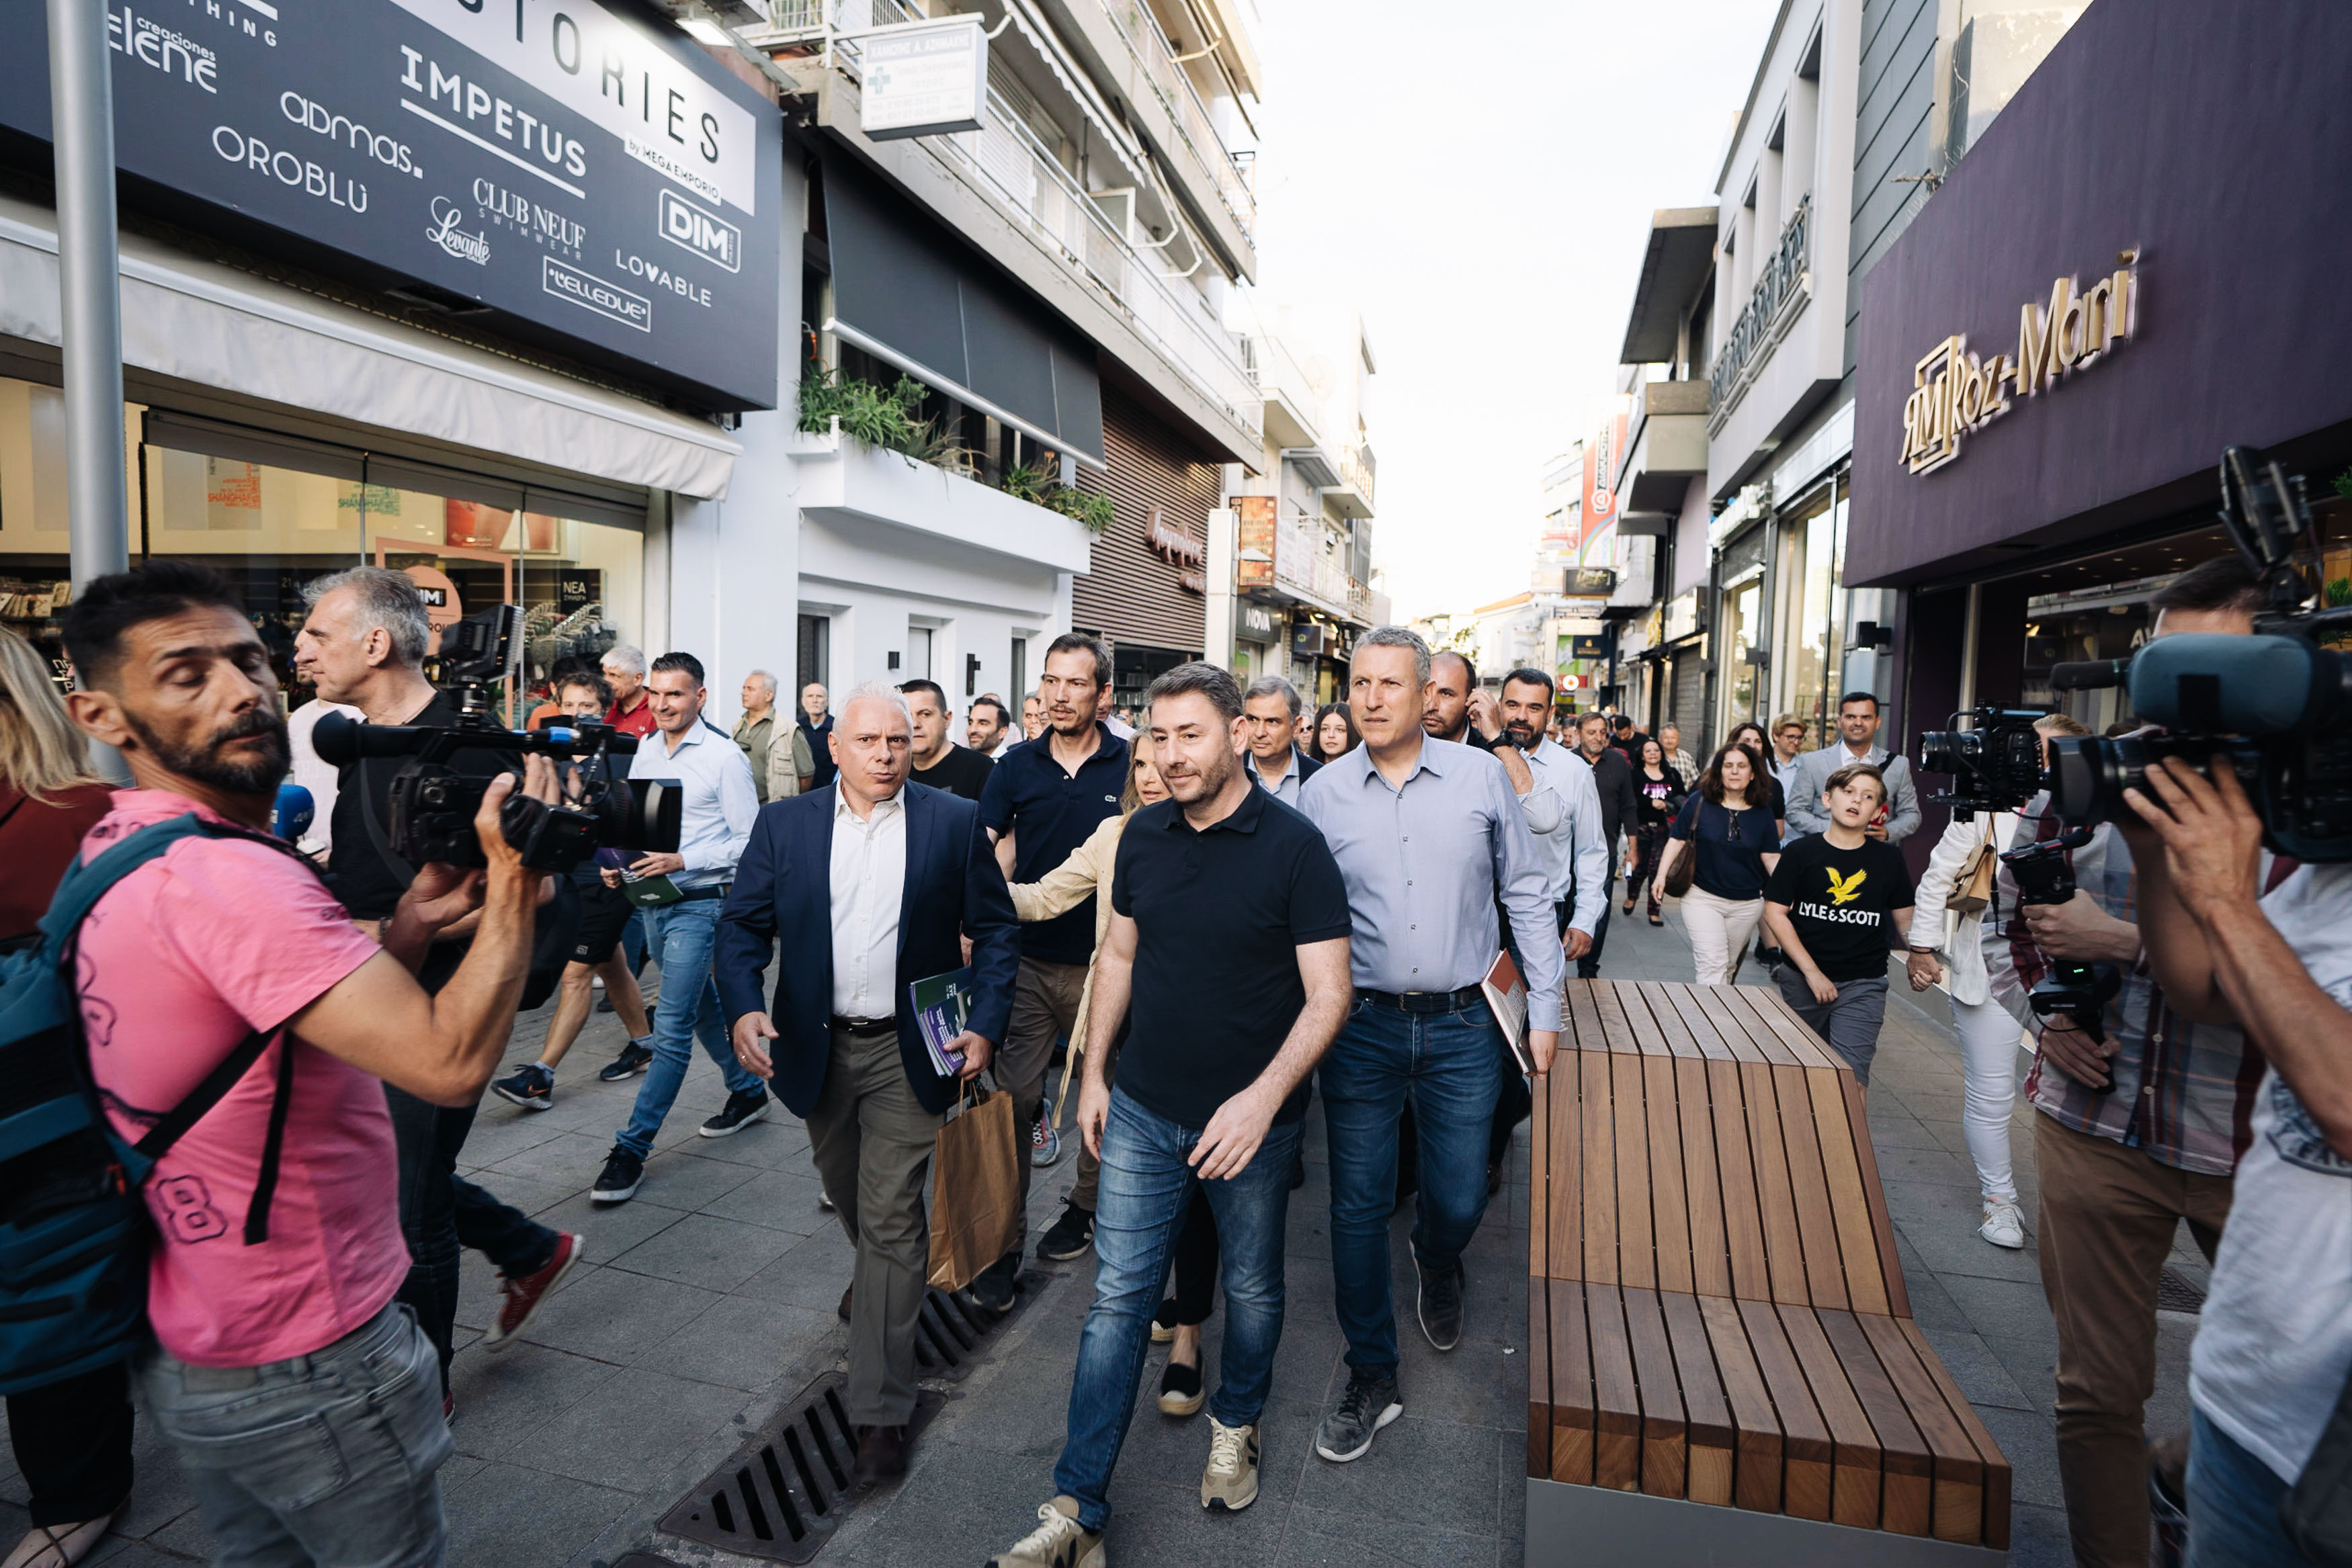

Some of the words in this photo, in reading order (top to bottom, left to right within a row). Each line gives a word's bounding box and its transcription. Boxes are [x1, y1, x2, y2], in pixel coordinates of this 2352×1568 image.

[136, 17, 216, 62] creaciones
[189, 0, 277, 47] HING
[459, 0, 720, 164] TORIES
[401, 44, 587, 178] IMPETUS
[212, 126, 368, 213] OROBLÙ
[630, 138, 640, 155] by
[643, 145, 673, 172] MEGA
[426, 195, 491, 262] Levante
[473, 177, 530, 225] CLUB
[533, 204, 586, 250] NEUF
[478, 208, 582, 262] SWIMWEAR
[669, 200, 728, 261] DIM
[338, 498, 382, 508] SHANHAI
[563, 581, 587, 594] ΝΕΑ
[1246, 607, 1271, 632] NOVA
